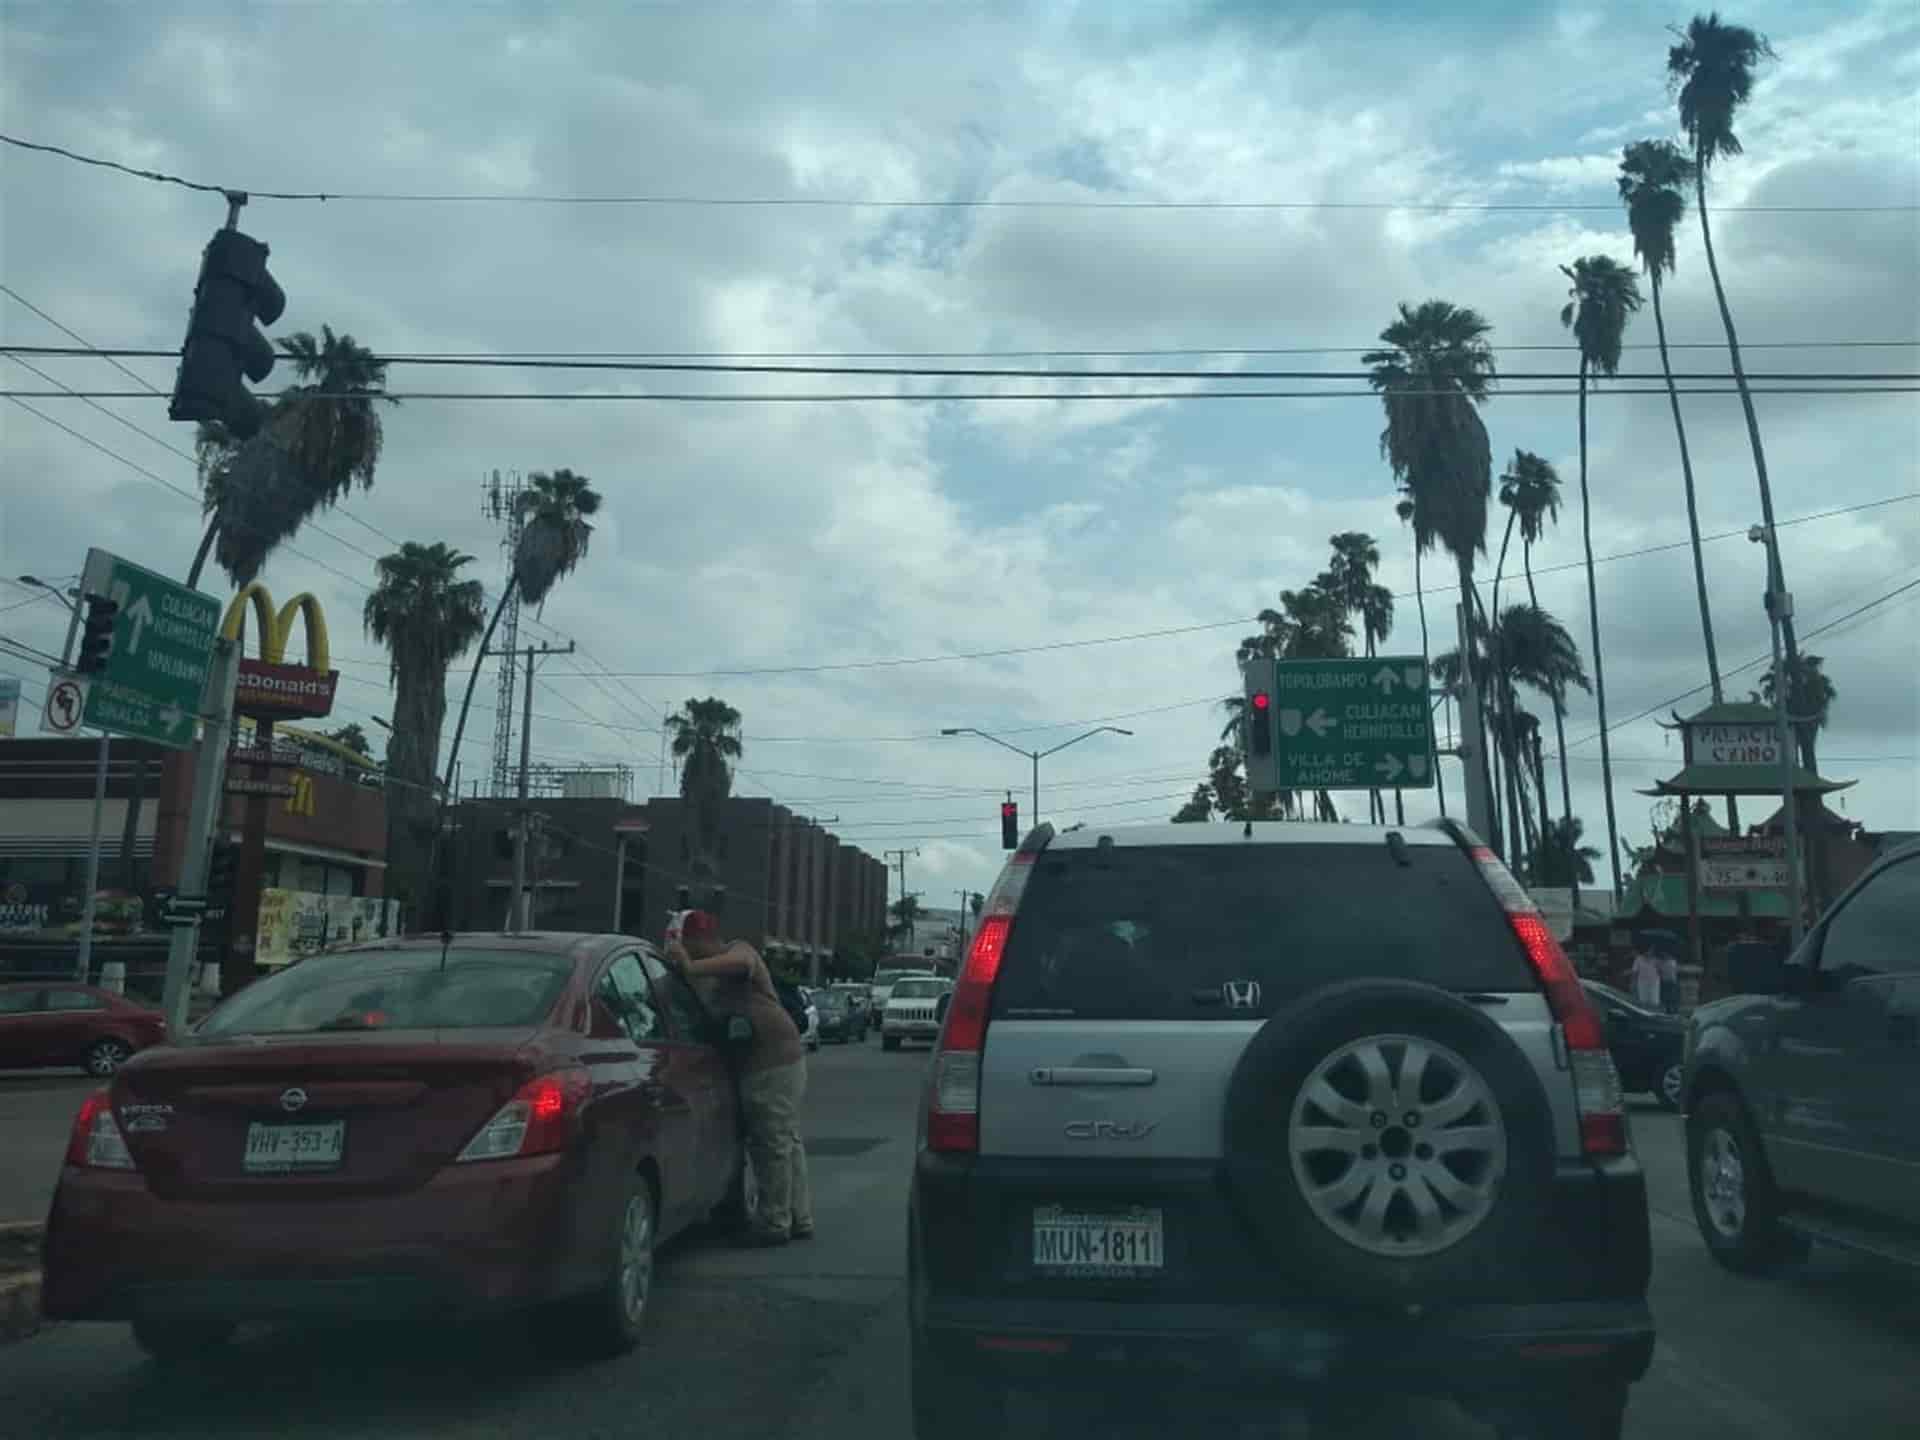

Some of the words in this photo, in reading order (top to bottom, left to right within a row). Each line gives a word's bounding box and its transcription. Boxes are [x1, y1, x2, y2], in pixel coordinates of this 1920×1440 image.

[1345, 703, 1422, 719] CULIACAN
[1288, 752, 1337, 768] VILLA
[1343, 752, 1368, 767] DE
[1297, 768, 1356, 785] AHOME
[1040, 1229, 1151, 1263] MUN-1811
